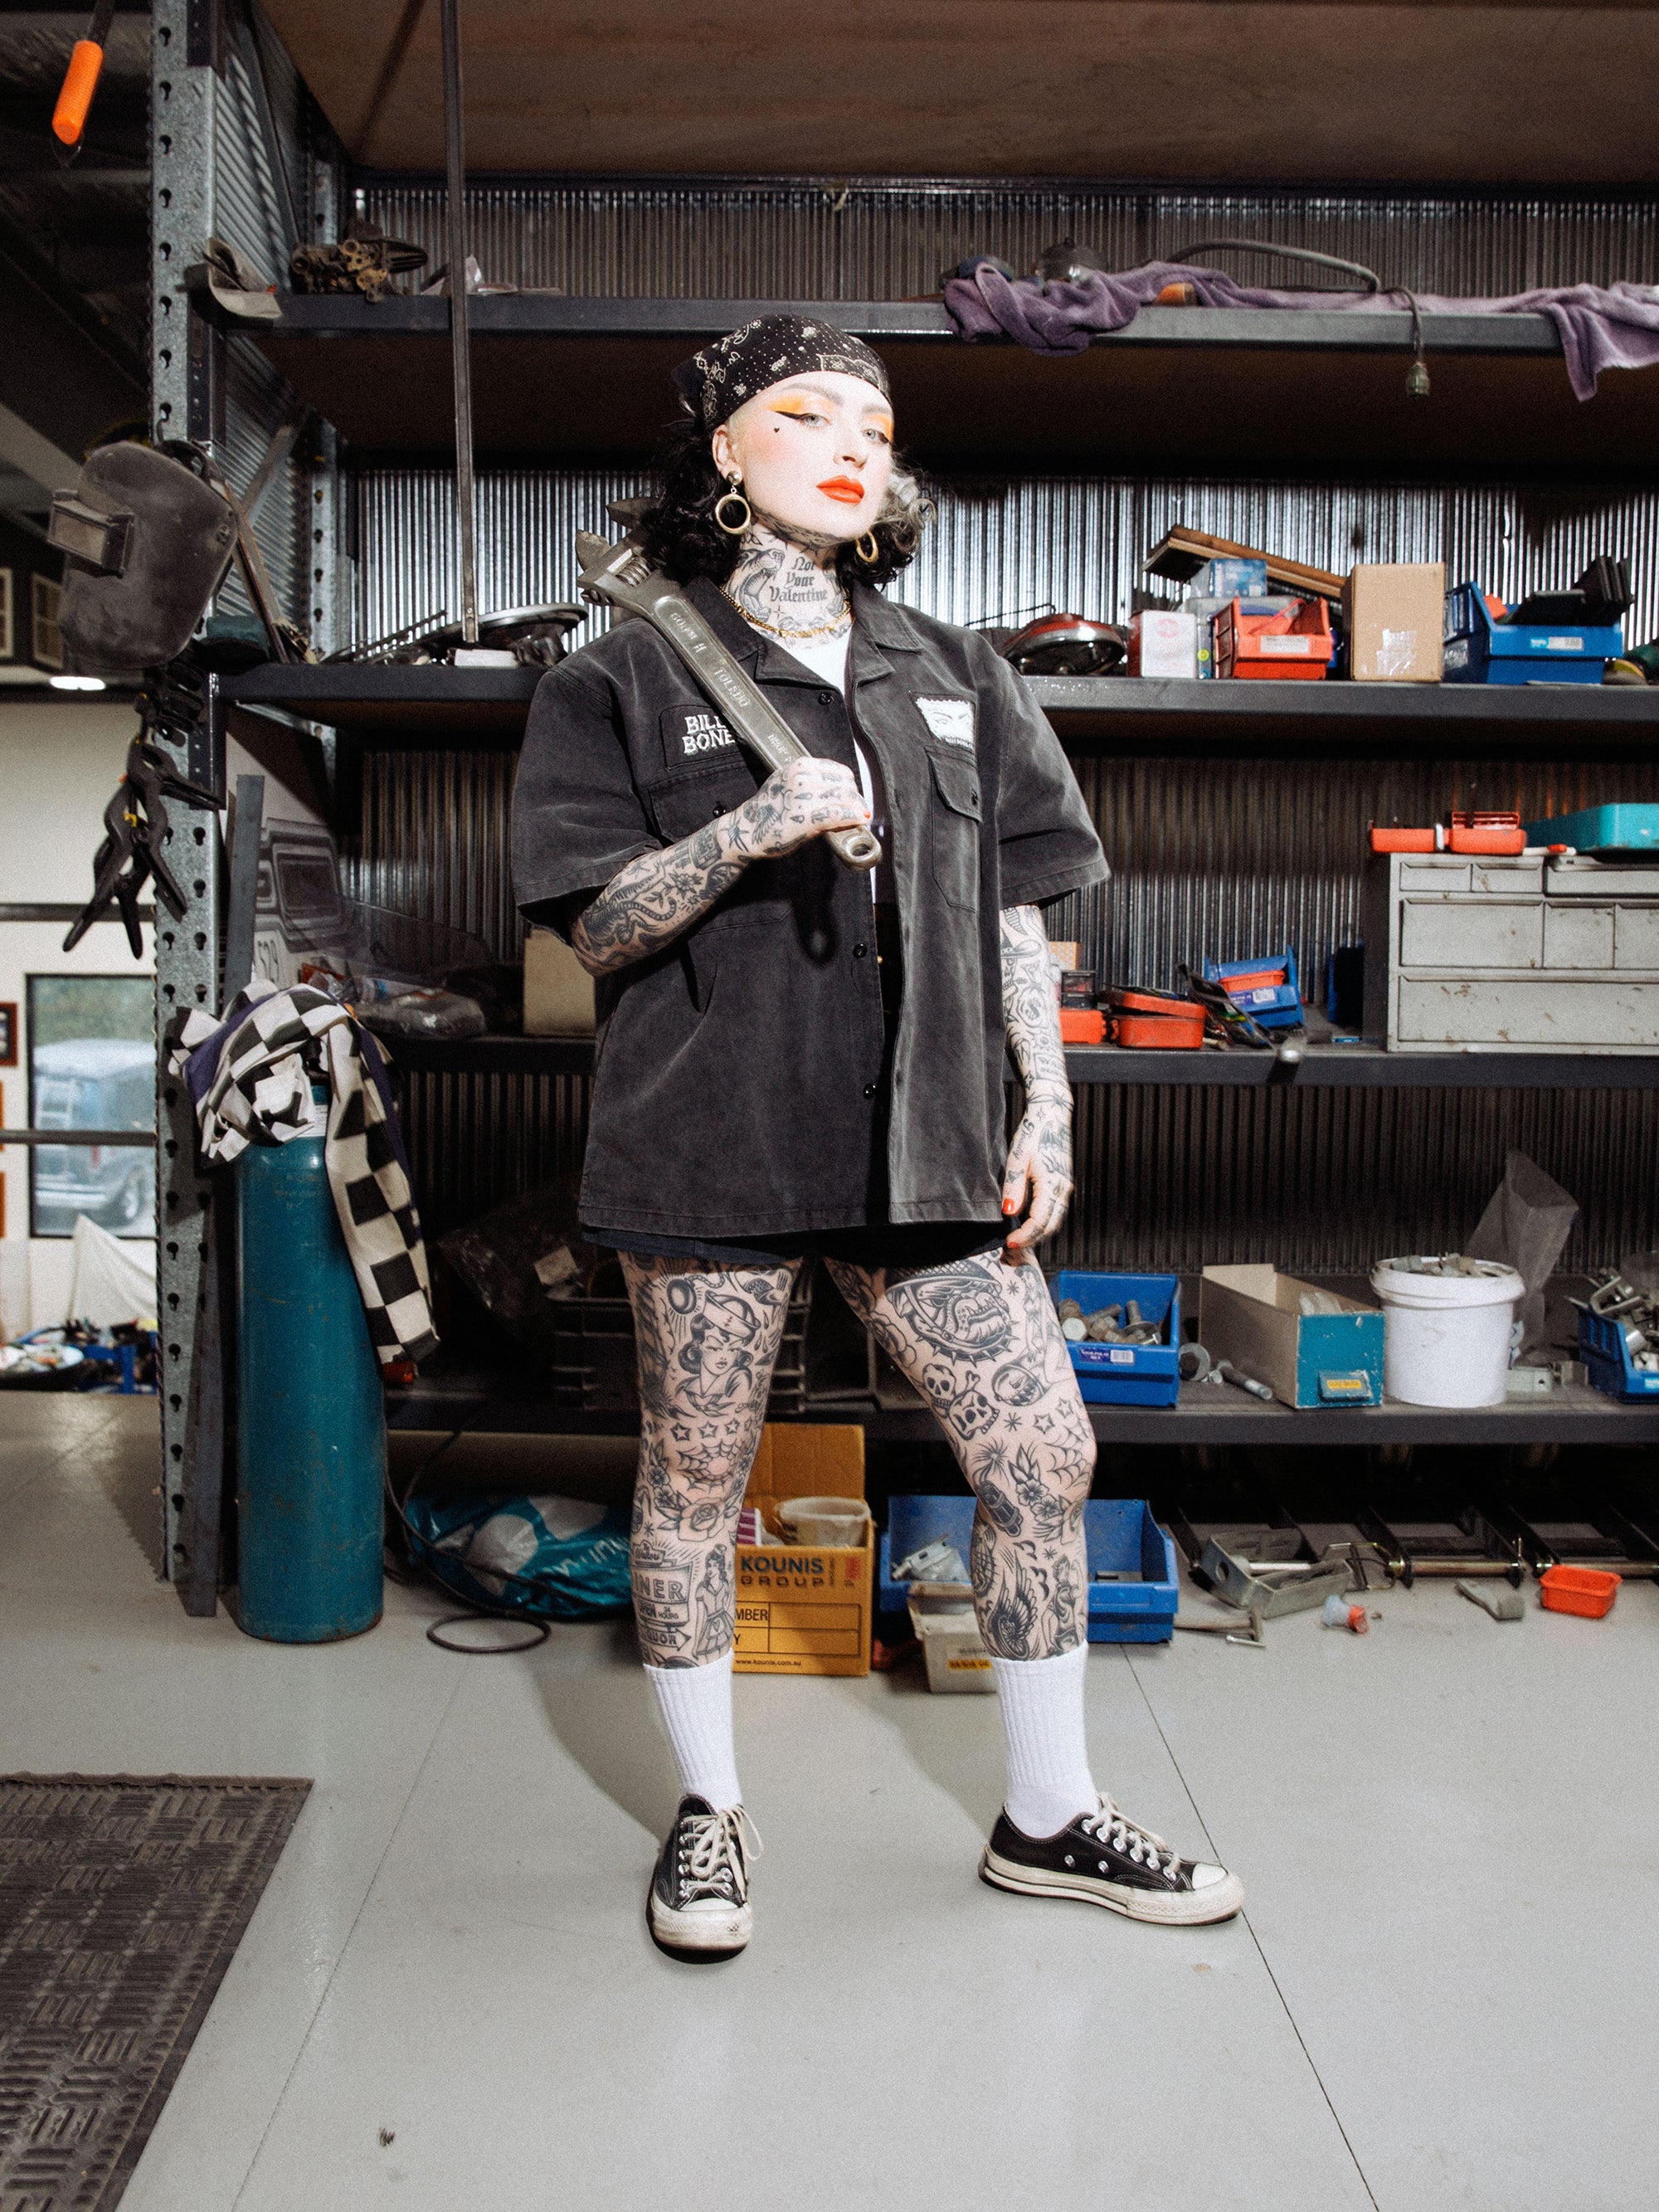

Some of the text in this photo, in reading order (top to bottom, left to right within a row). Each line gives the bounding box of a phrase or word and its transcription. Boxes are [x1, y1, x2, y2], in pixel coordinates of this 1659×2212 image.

[783, 572, 815, 589] Your
[769, 586, 828, 602] Valentine
[714, 667, 751, 707] TOLEDO
[741, 1555, 824, 1574] KOUNIS
[741, 1576, 825, 1587] GROUP
